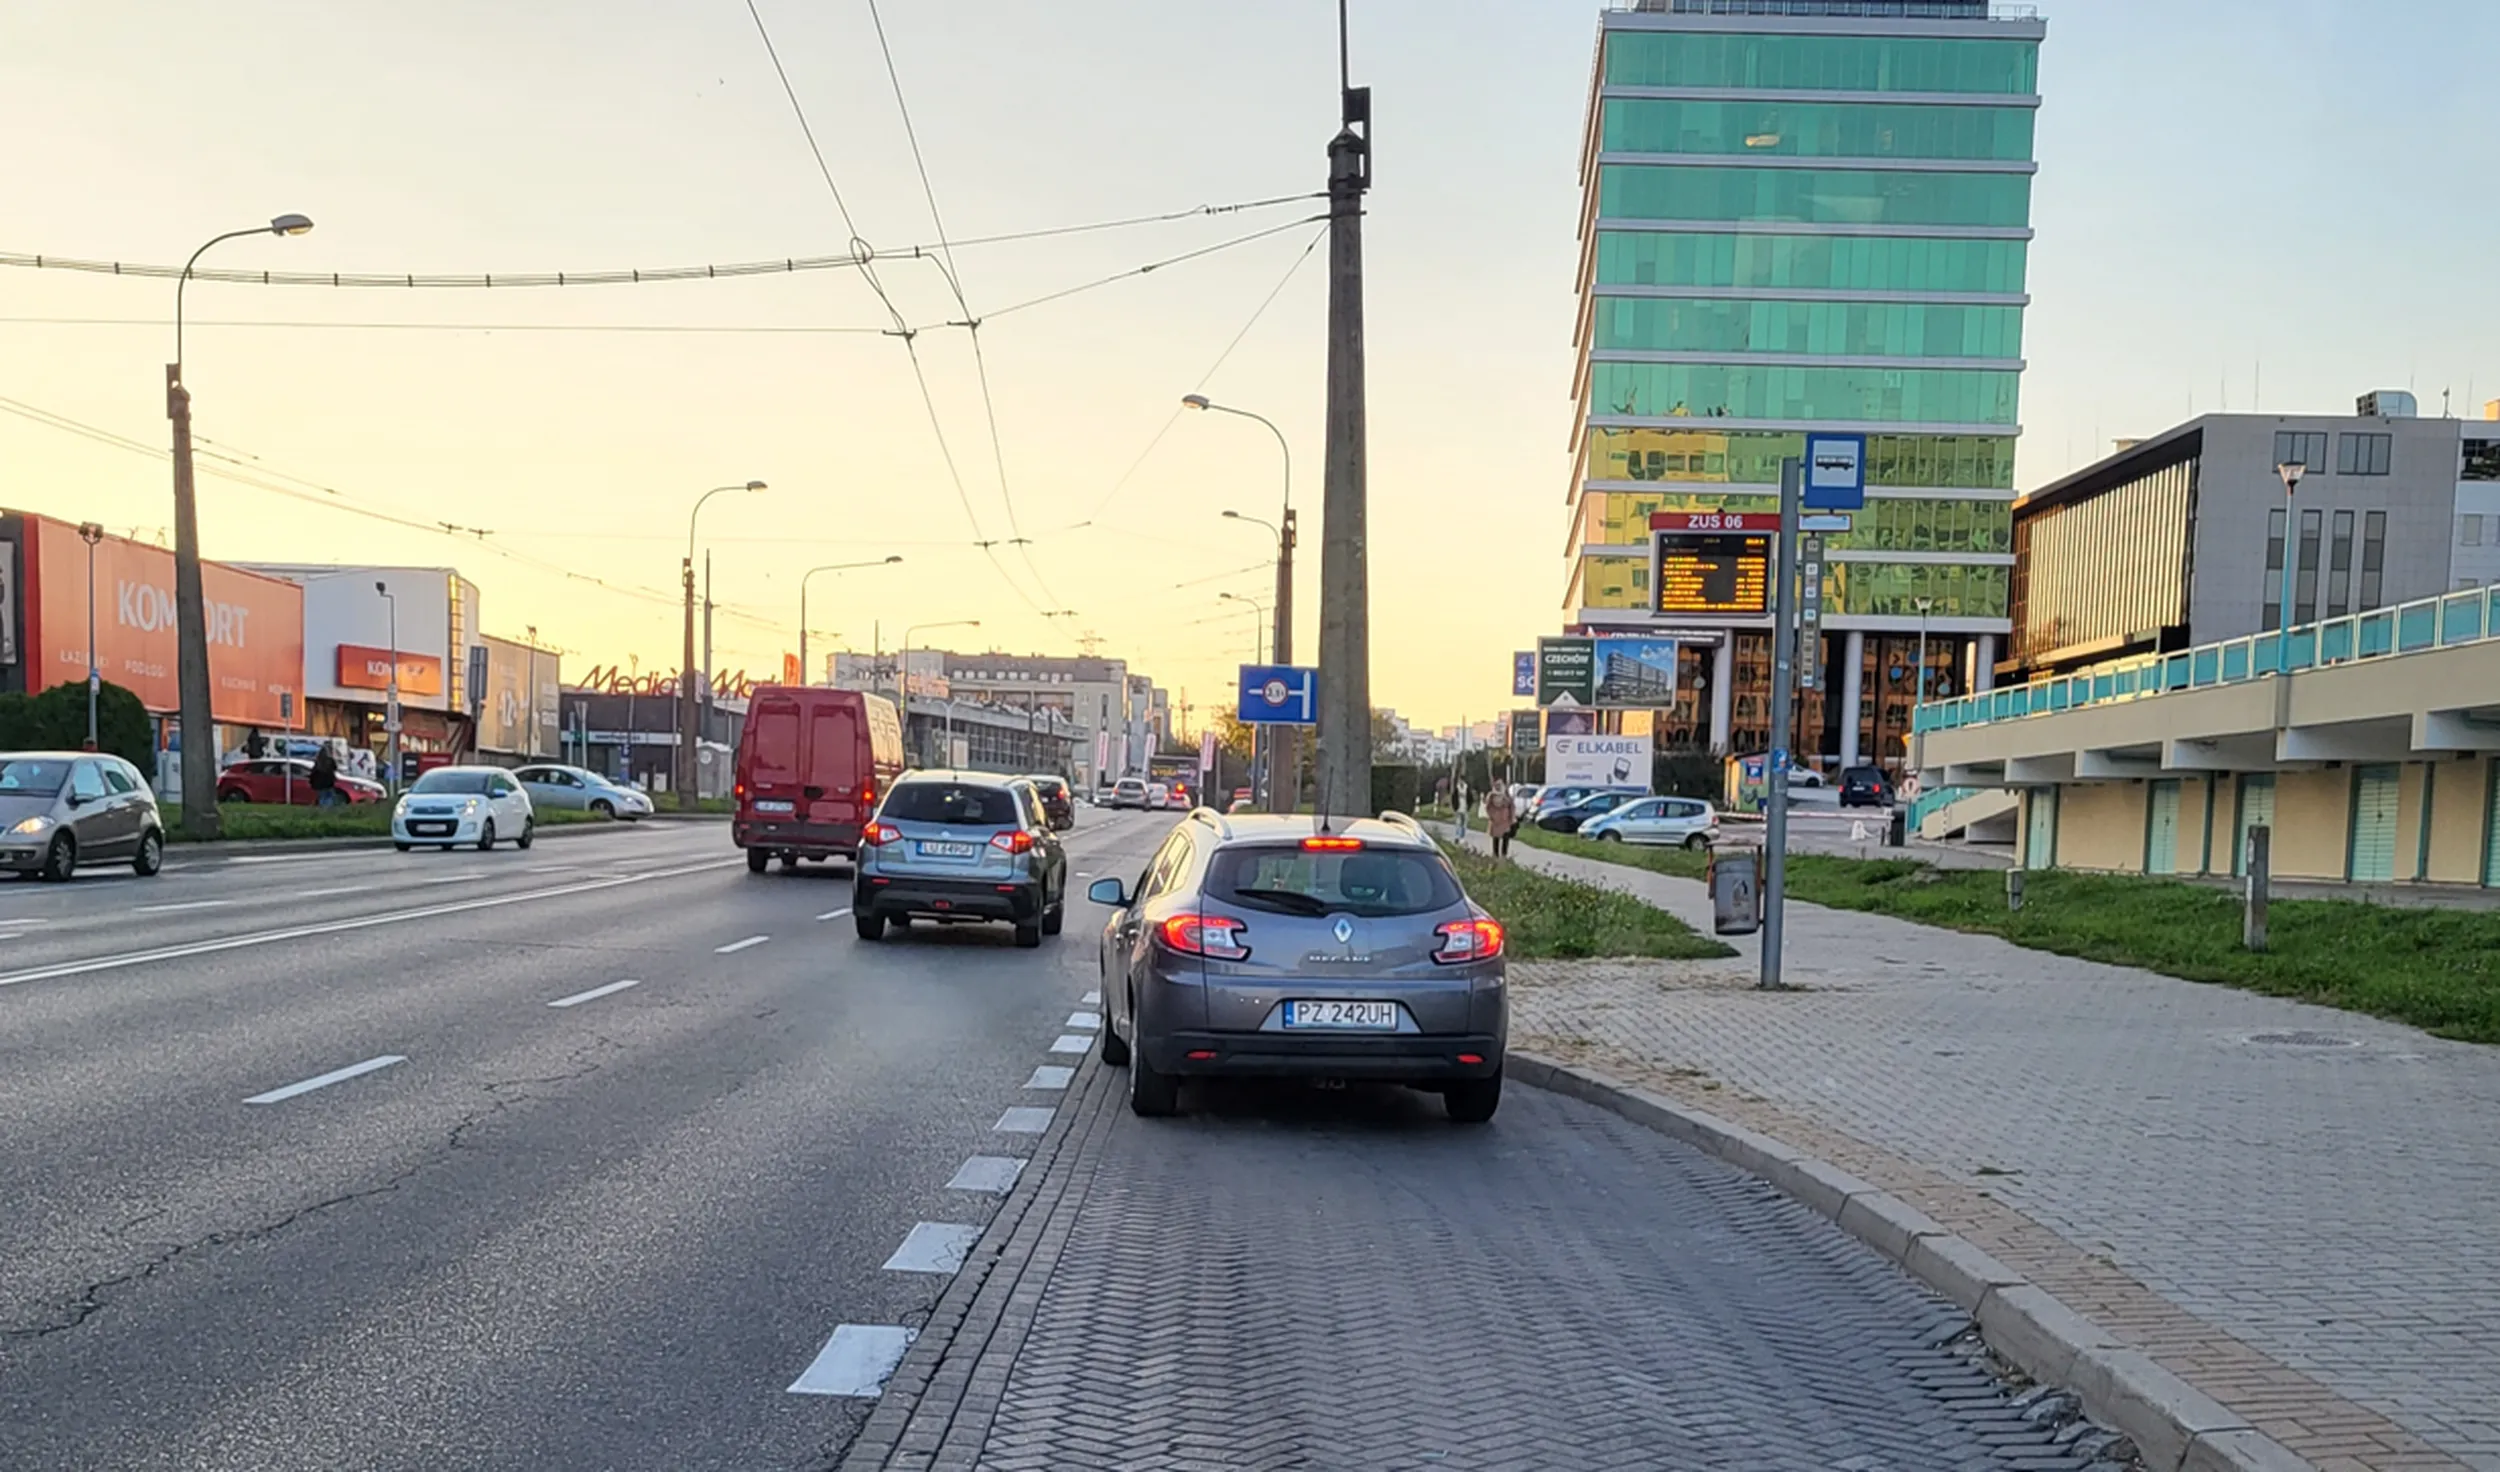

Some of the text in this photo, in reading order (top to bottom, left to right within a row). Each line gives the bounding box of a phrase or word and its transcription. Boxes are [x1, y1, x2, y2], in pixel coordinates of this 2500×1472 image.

[1688, 515, 1743, 528] ZUS 06
[118, 579, 249, 648] KOMORT
[576, 665, 677, 696] Media
[1577, 742, 1642, 754] ELKABEL
[1298, 1003, 1393, 1024] PZ 242UH
